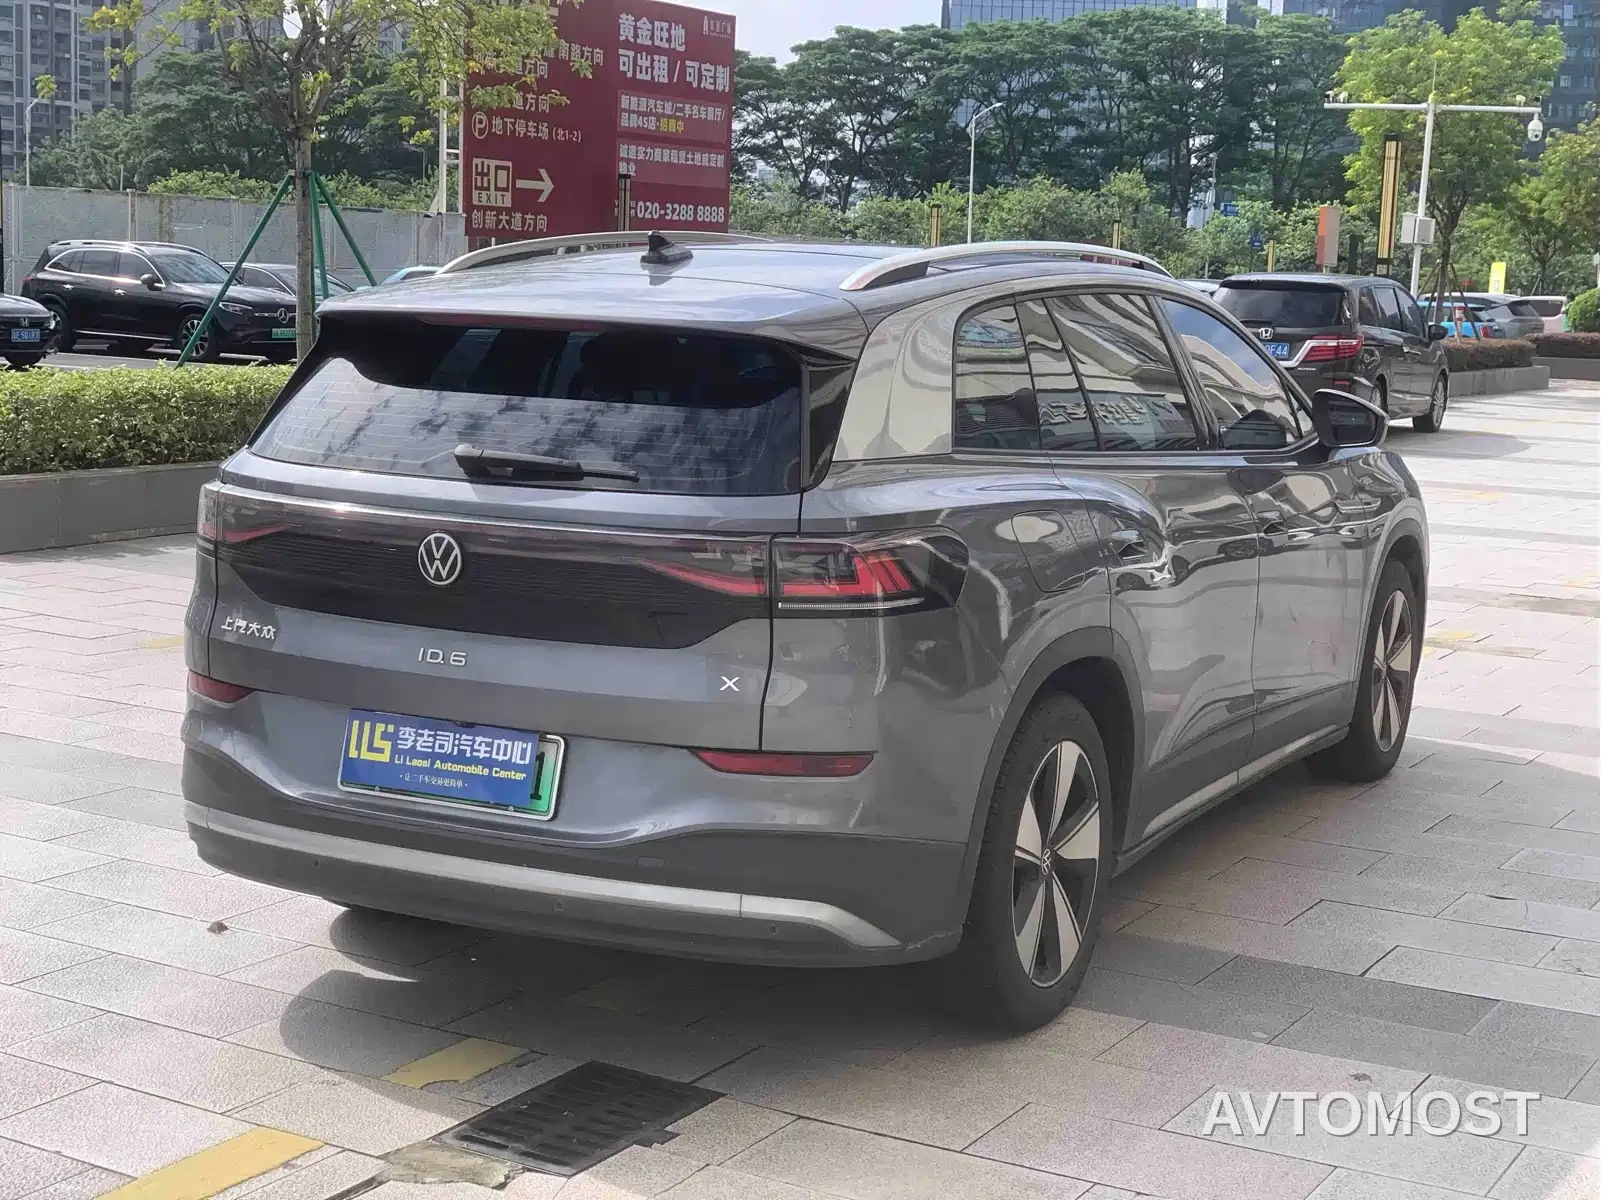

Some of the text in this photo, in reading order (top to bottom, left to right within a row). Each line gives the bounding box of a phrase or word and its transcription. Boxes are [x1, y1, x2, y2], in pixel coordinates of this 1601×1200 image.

[618, 12, 686, 52] 黄金旺地
[618, 48, 669, 84] 可出租
[685, 59, 730, 93] 可定制
[491, 115, 549, 140] 地下停车场
[474, 160, 511, 192] 出口
[477, 192, 506, 205] EXIT
[637, 199, 694, 221] 020-3288
[696, 204, 725, 223] 8888
[471, 208, 548, 233] 创新大道方向
[220, 616, 277, 640] 上汽大众
[718, 675, 740, 692] X
[396, 726, 533, 766] 李老司汽车中心
[406, 756, 431, 769] Laosi
[433, 759, 490, 777] Automobile
[491, 767, 527, 781] Center
